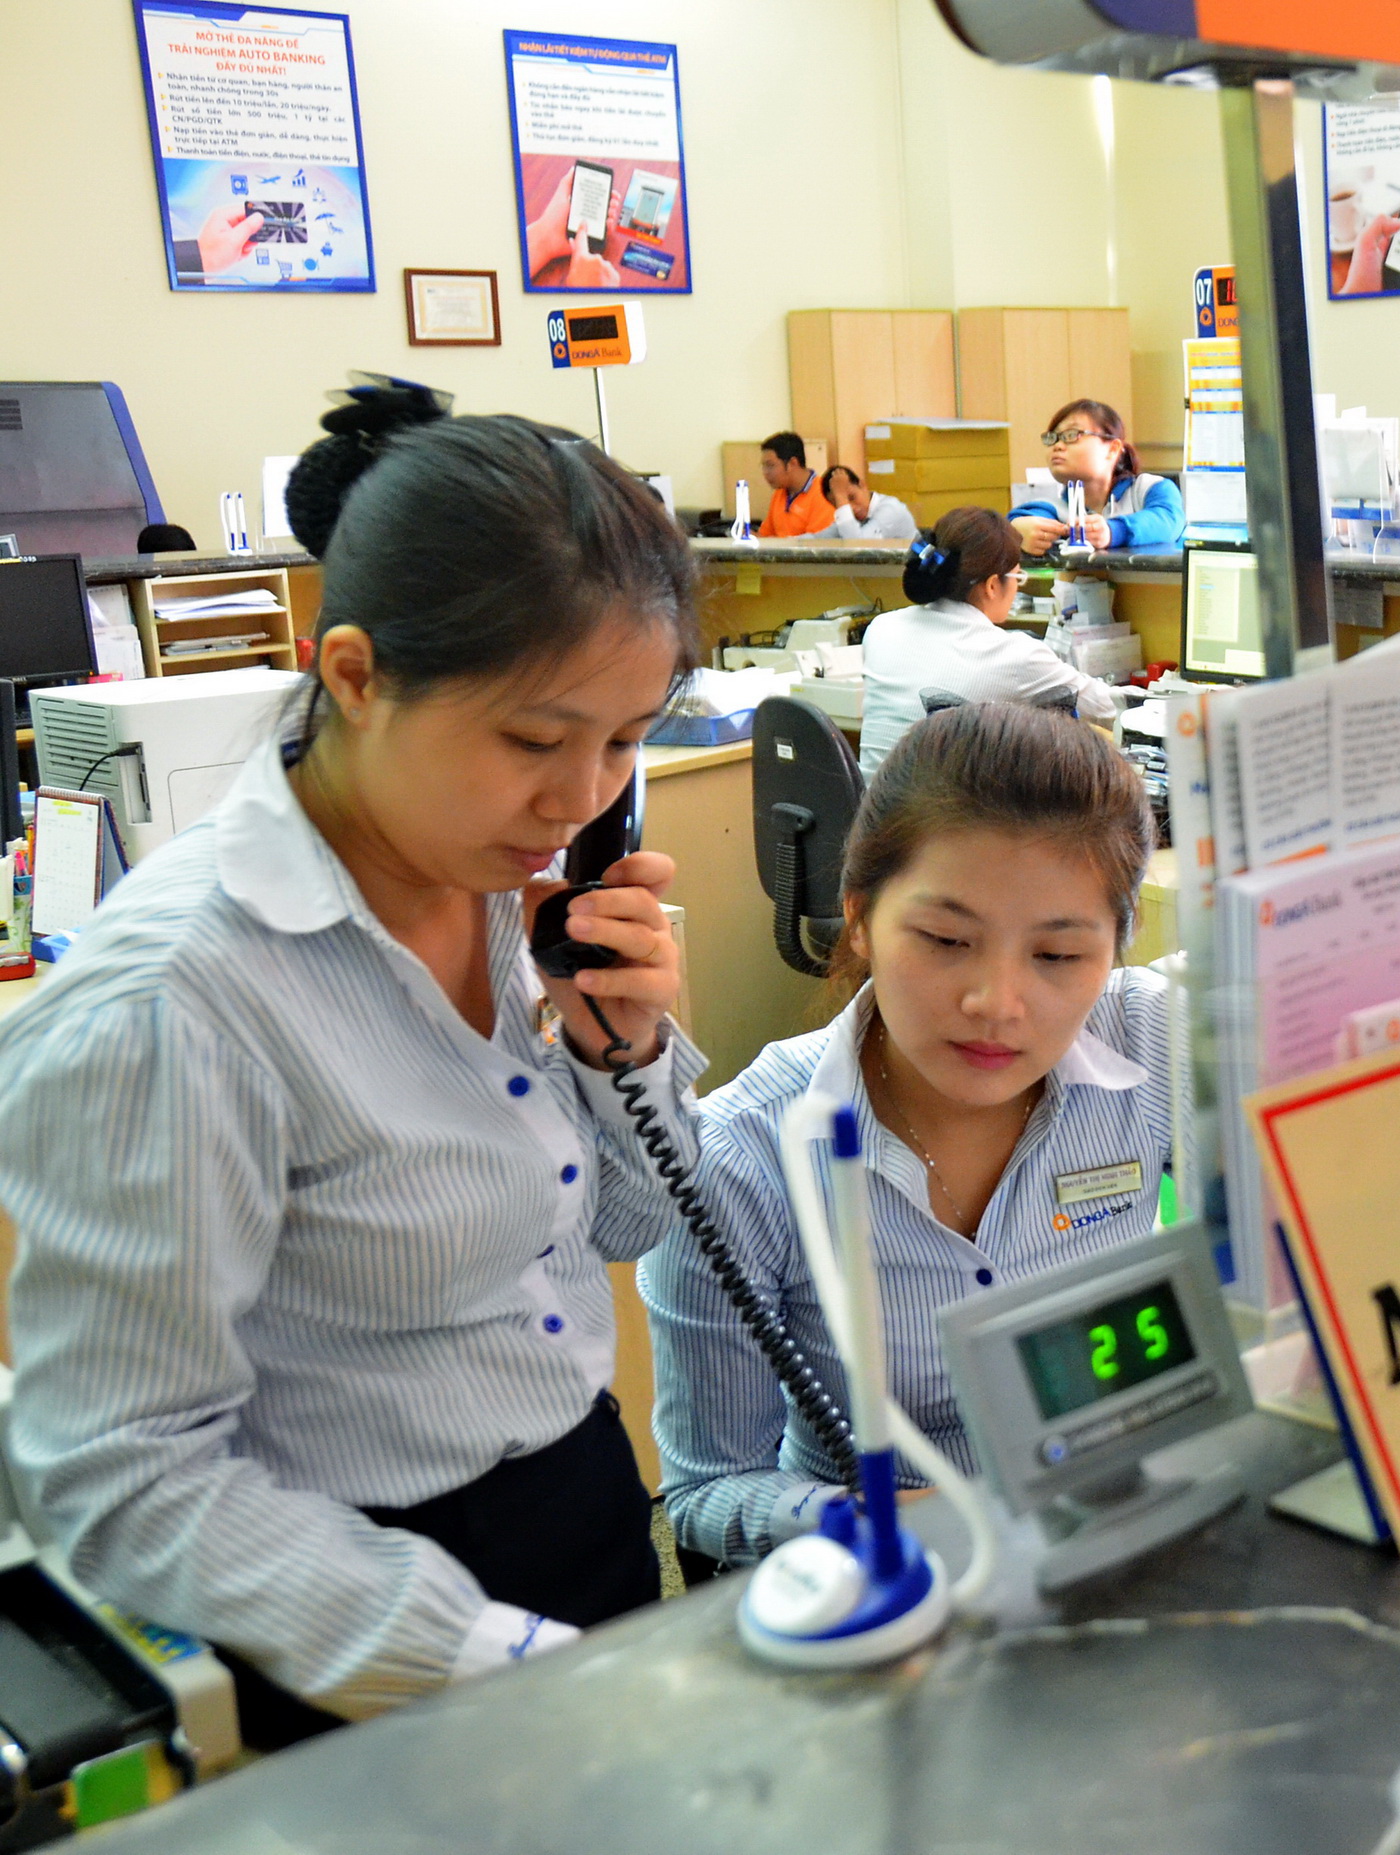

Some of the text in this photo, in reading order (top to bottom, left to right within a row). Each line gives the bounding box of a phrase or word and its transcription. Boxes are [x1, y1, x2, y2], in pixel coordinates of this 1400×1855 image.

[240, 49, 270, 60] AUTO
[274, 52, 326, 64] BANKING
[1196, 278, 1212, 306] 07
[550, 318, 566, 342] 08
[601, 347, 622, 357] Bank
[1072, 1201, 1133, 1229] DONGA Bank
